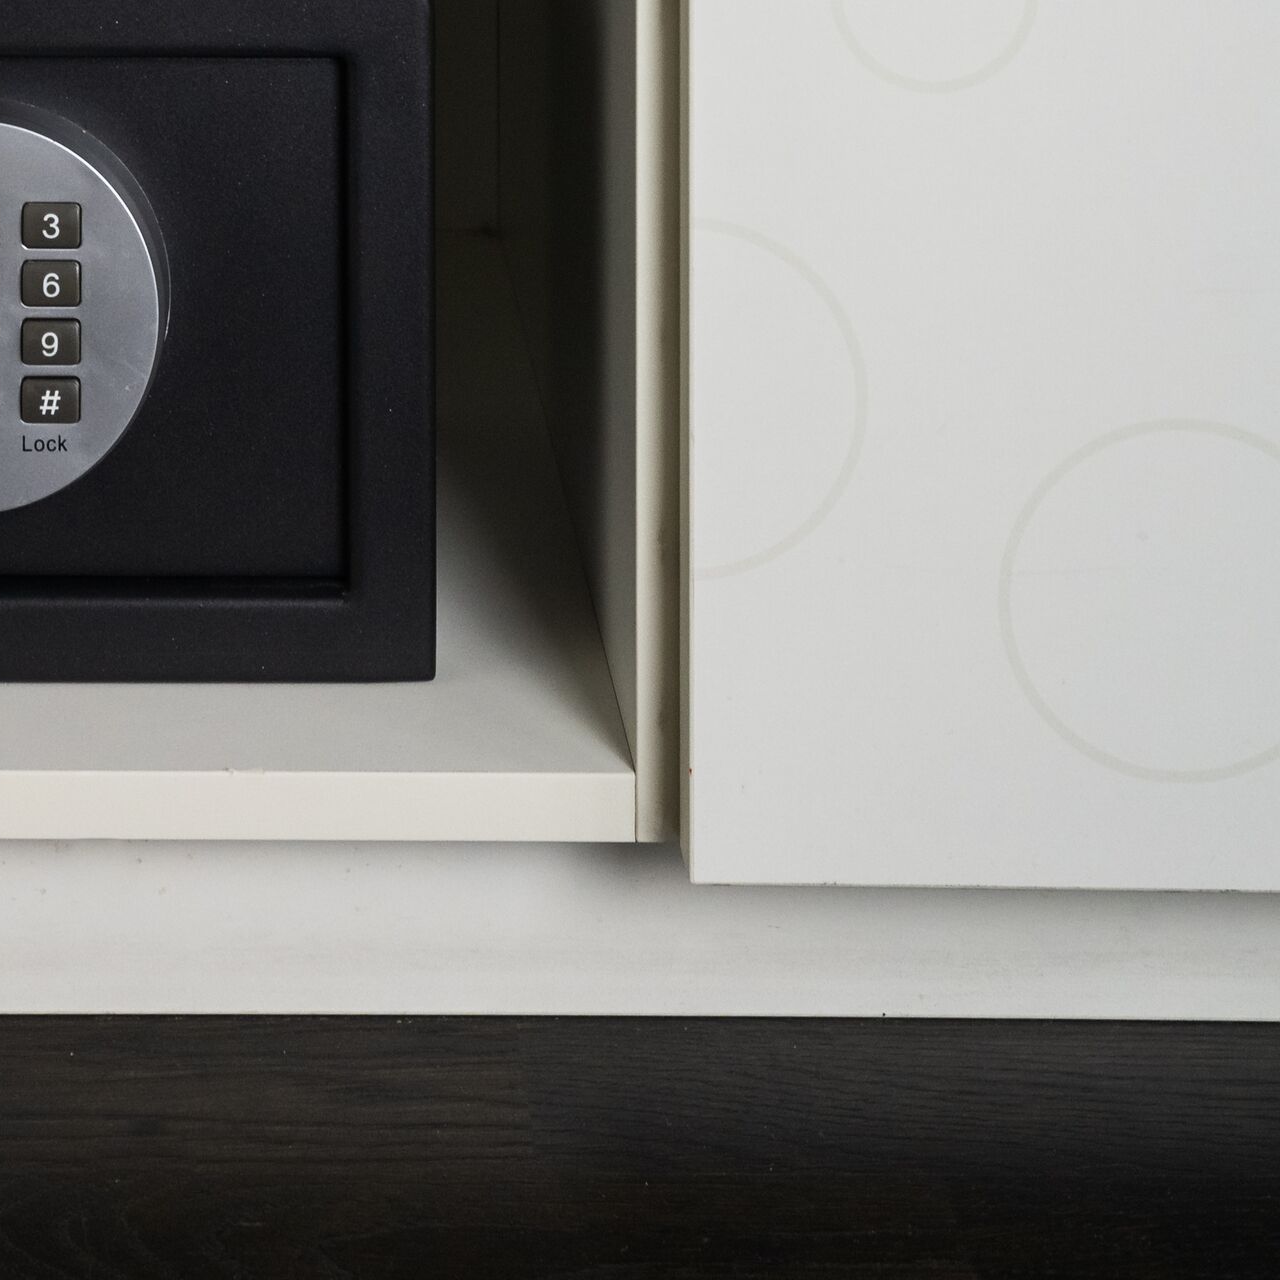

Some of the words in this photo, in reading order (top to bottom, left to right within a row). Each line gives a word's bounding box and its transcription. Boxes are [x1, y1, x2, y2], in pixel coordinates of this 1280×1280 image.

[43, 214, 59, 239] 3
[43, 273, 60, 297] 6
[42, 332, 58, 356] 9
[40, 390, 61, 415] #
[22, 435, 68, 453] Lock
